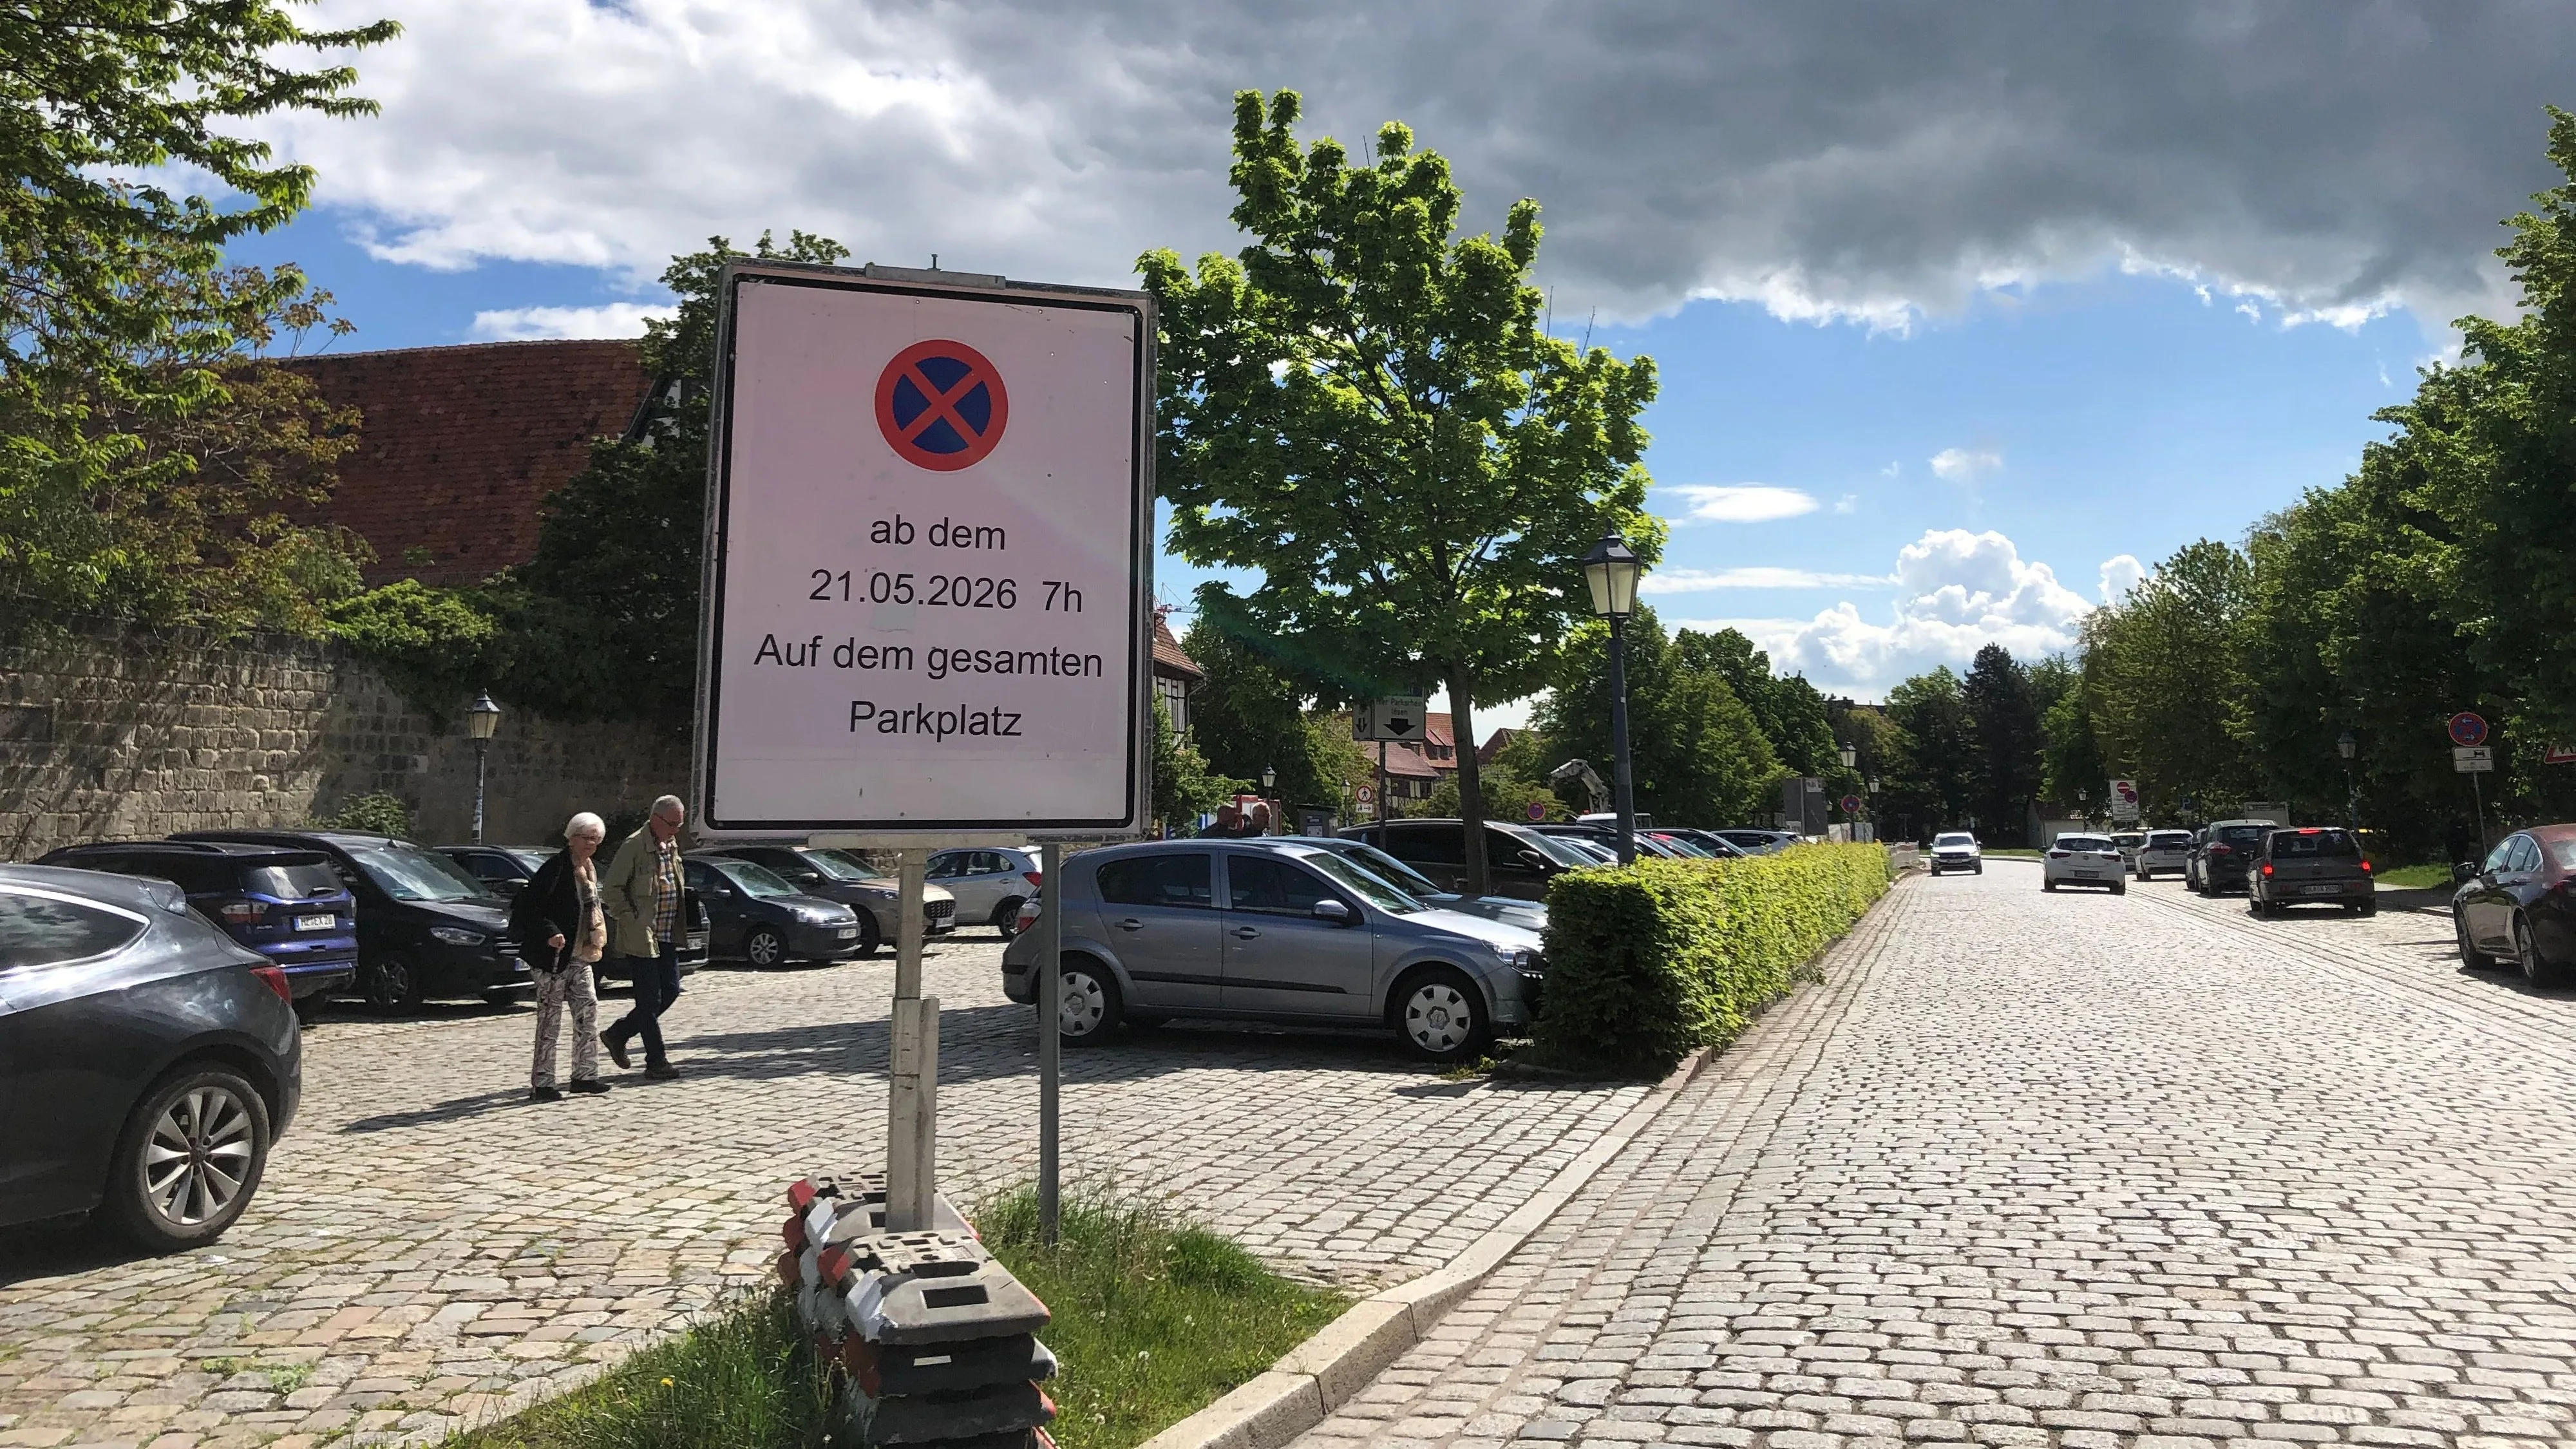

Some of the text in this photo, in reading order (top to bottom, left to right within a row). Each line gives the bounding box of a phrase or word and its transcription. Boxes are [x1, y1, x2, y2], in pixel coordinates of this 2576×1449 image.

[870, 514, 1006, 550] ab dem
[809, 569, 1083, 612] 21.05.2026 7h
[753, 634, 1103, 680] Auf dem gesamten
[849, 700, 1022, 743] Parkplatz
